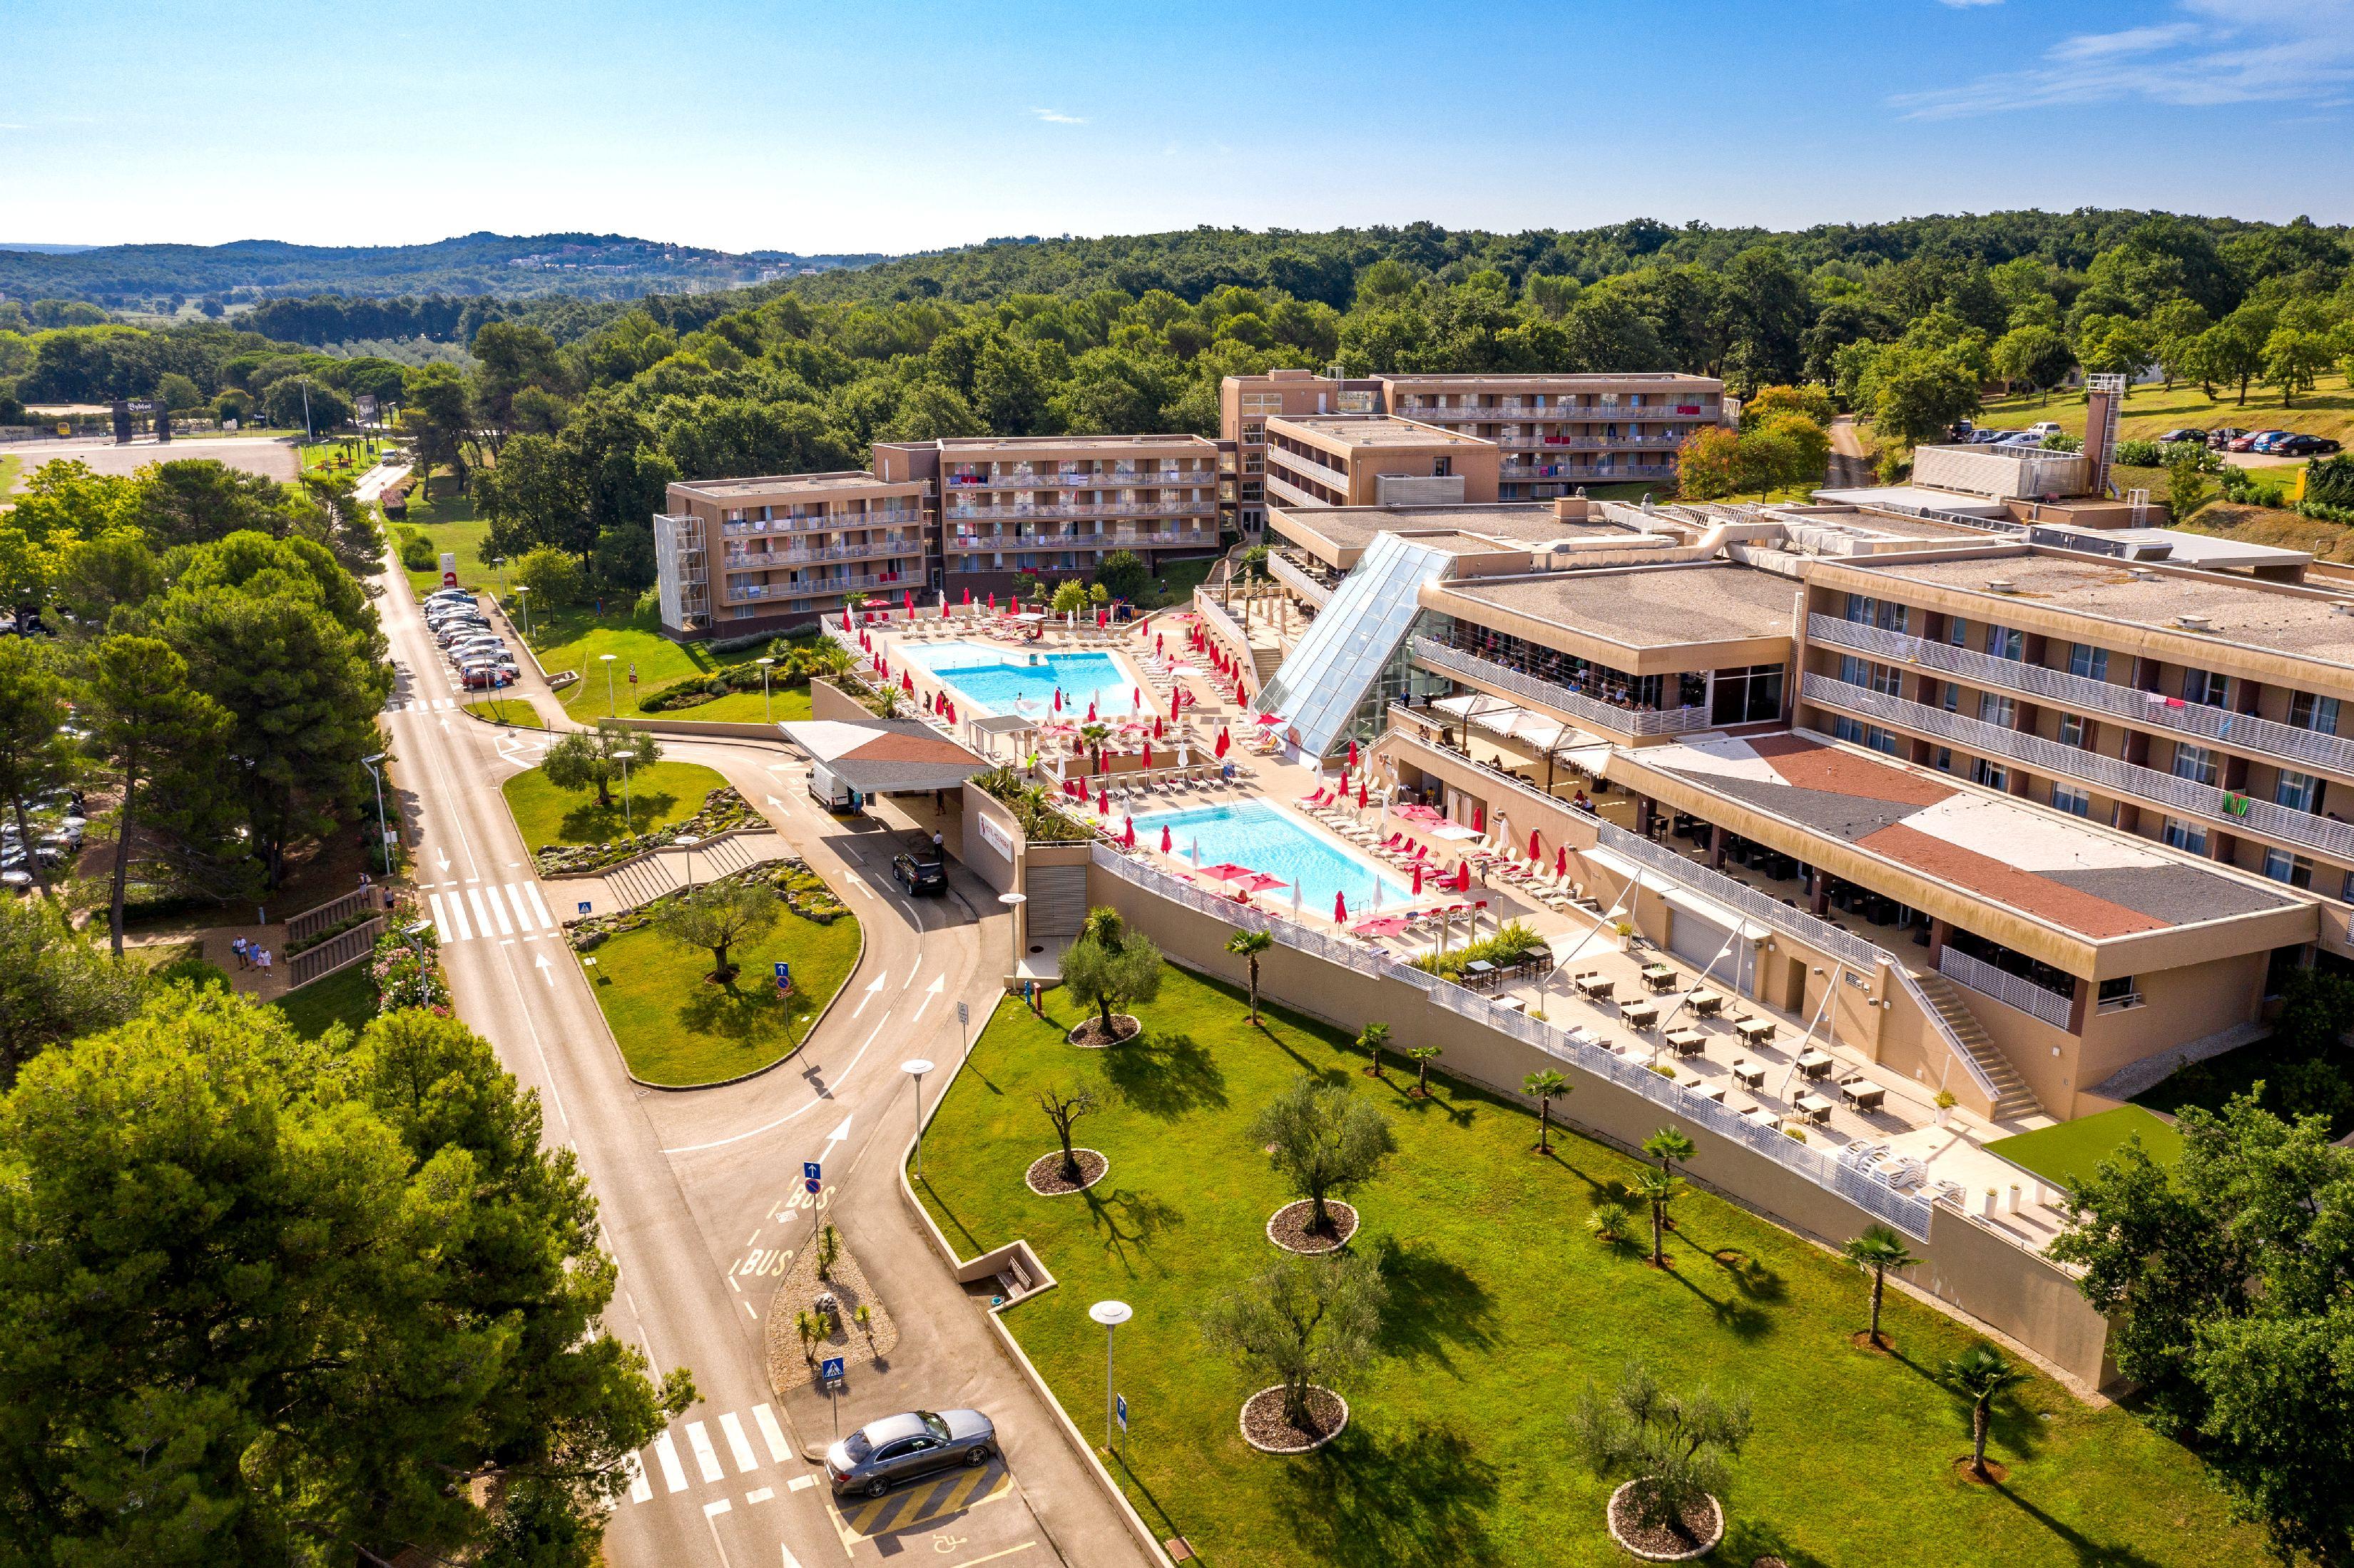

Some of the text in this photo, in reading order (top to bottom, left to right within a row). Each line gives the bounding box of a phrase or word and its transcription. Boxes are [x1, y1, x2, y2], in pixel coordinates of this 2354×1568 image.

[785, 1183, 837, 1211] BUS
[738, 1248, 794, 1277] BUS
[1119, 1400, 1124, 1413] P
